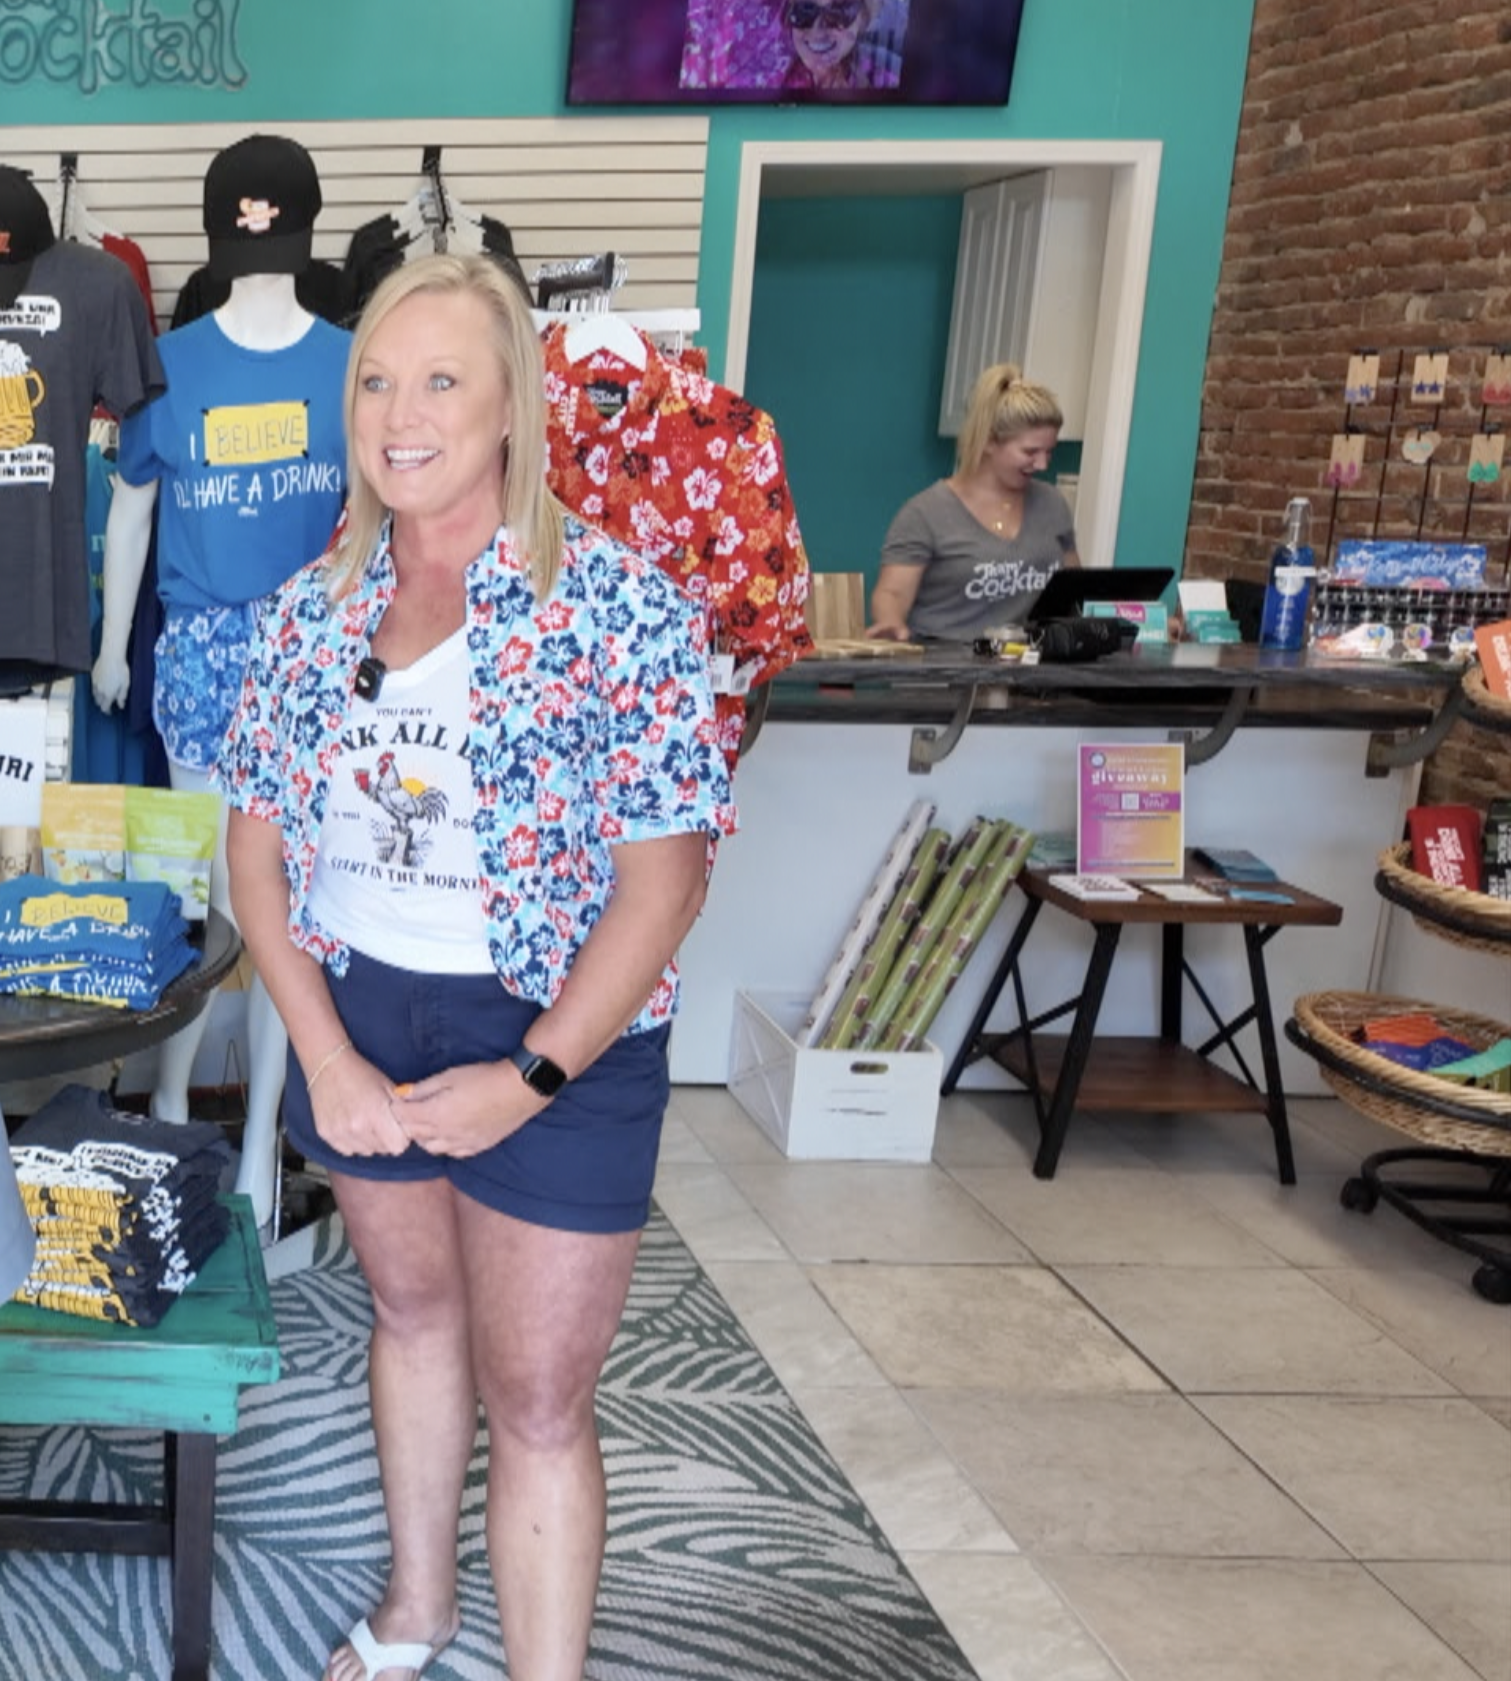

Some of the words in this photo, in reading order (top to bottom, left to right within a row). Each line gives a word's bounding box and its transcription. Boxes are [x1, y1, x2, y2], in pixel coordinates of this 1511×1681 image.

[215, 415, 306, 457] BELIEVE
[194, 474, 240, 509] HAVE
[247, 472, 263, 504] A
[271, 462, 341, 502] DRINK!
[377, 708, 399, 717] YOU
[401, 708, 433, 717] CAN'T
[390, 722, 448, 751] ALL
[1091, 769, 1168, 786] giveaway
[370, 865, 383, 881] IN
[387, 869, 418, 885] THE
[423, 870, 480, 891] MORNI
